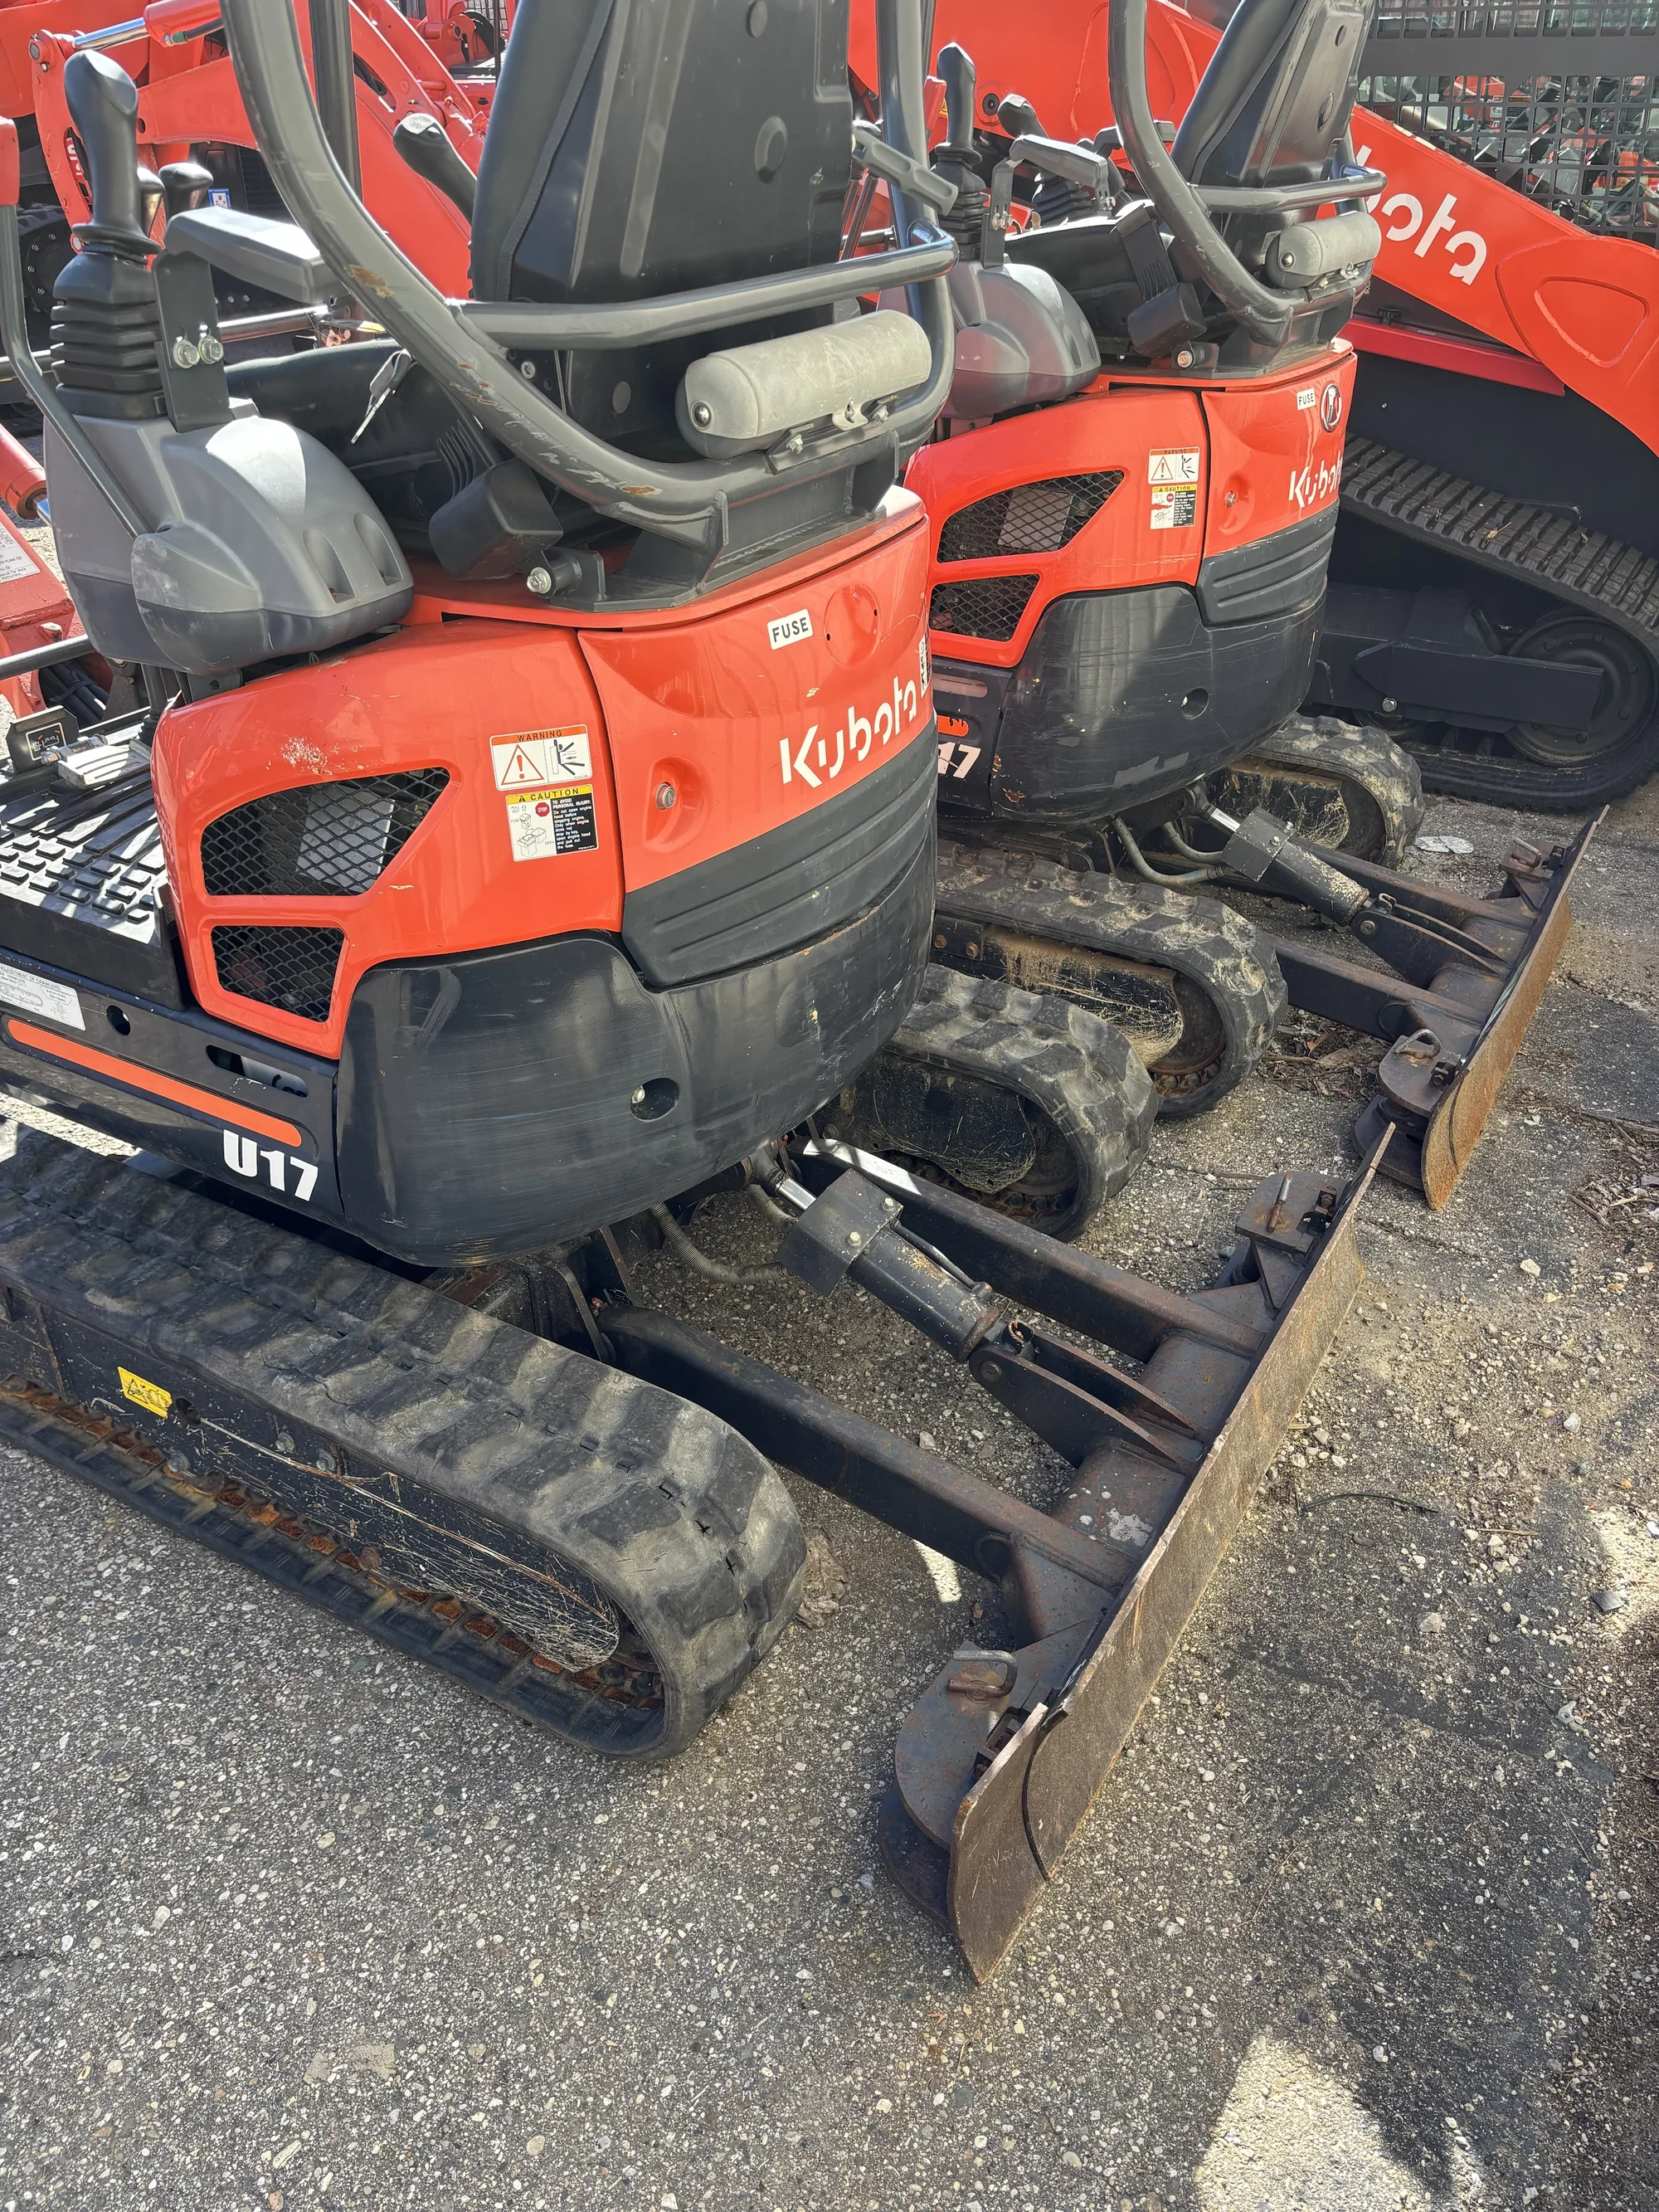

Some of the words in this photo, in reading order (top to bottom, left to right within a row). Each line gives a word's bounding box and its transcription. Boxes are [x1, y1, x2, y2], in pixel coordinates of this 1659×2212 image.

[1298, 392, 1314, 407] FUSE
[771, 616, 809, 642] FUSE
[518, 729, 562, 743] WARNING
[779, 676, 917, 788] Kubota
[530, 787, 579, 801] CAUTION
[223, 1128, 319, 1201] U17
